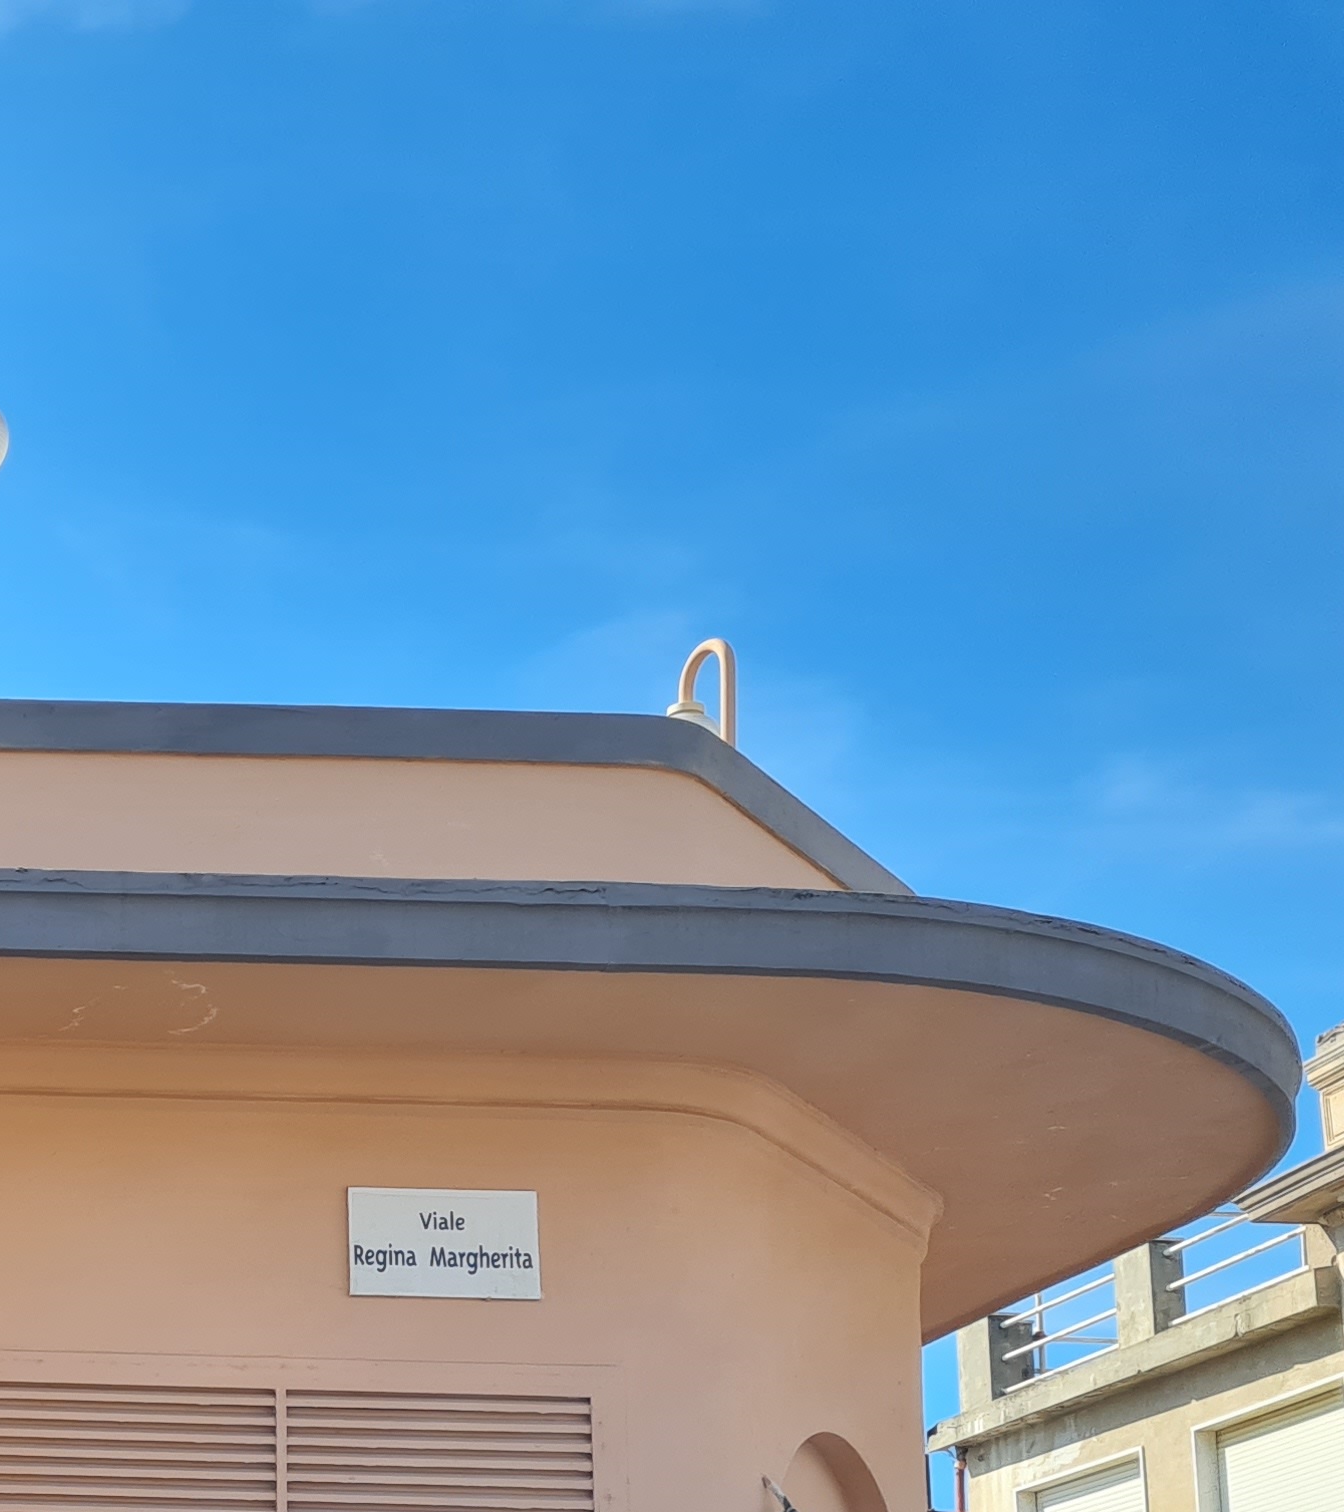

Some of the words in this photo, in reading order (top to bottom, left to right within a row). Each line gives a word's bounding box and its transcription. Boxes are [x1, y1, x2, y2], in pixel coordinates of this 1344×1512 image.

[418, 1210, 466, 1231] Viale
[353, 1243, 418, 1273] Regina
[429, 1245, 534, 1275] Margherita
